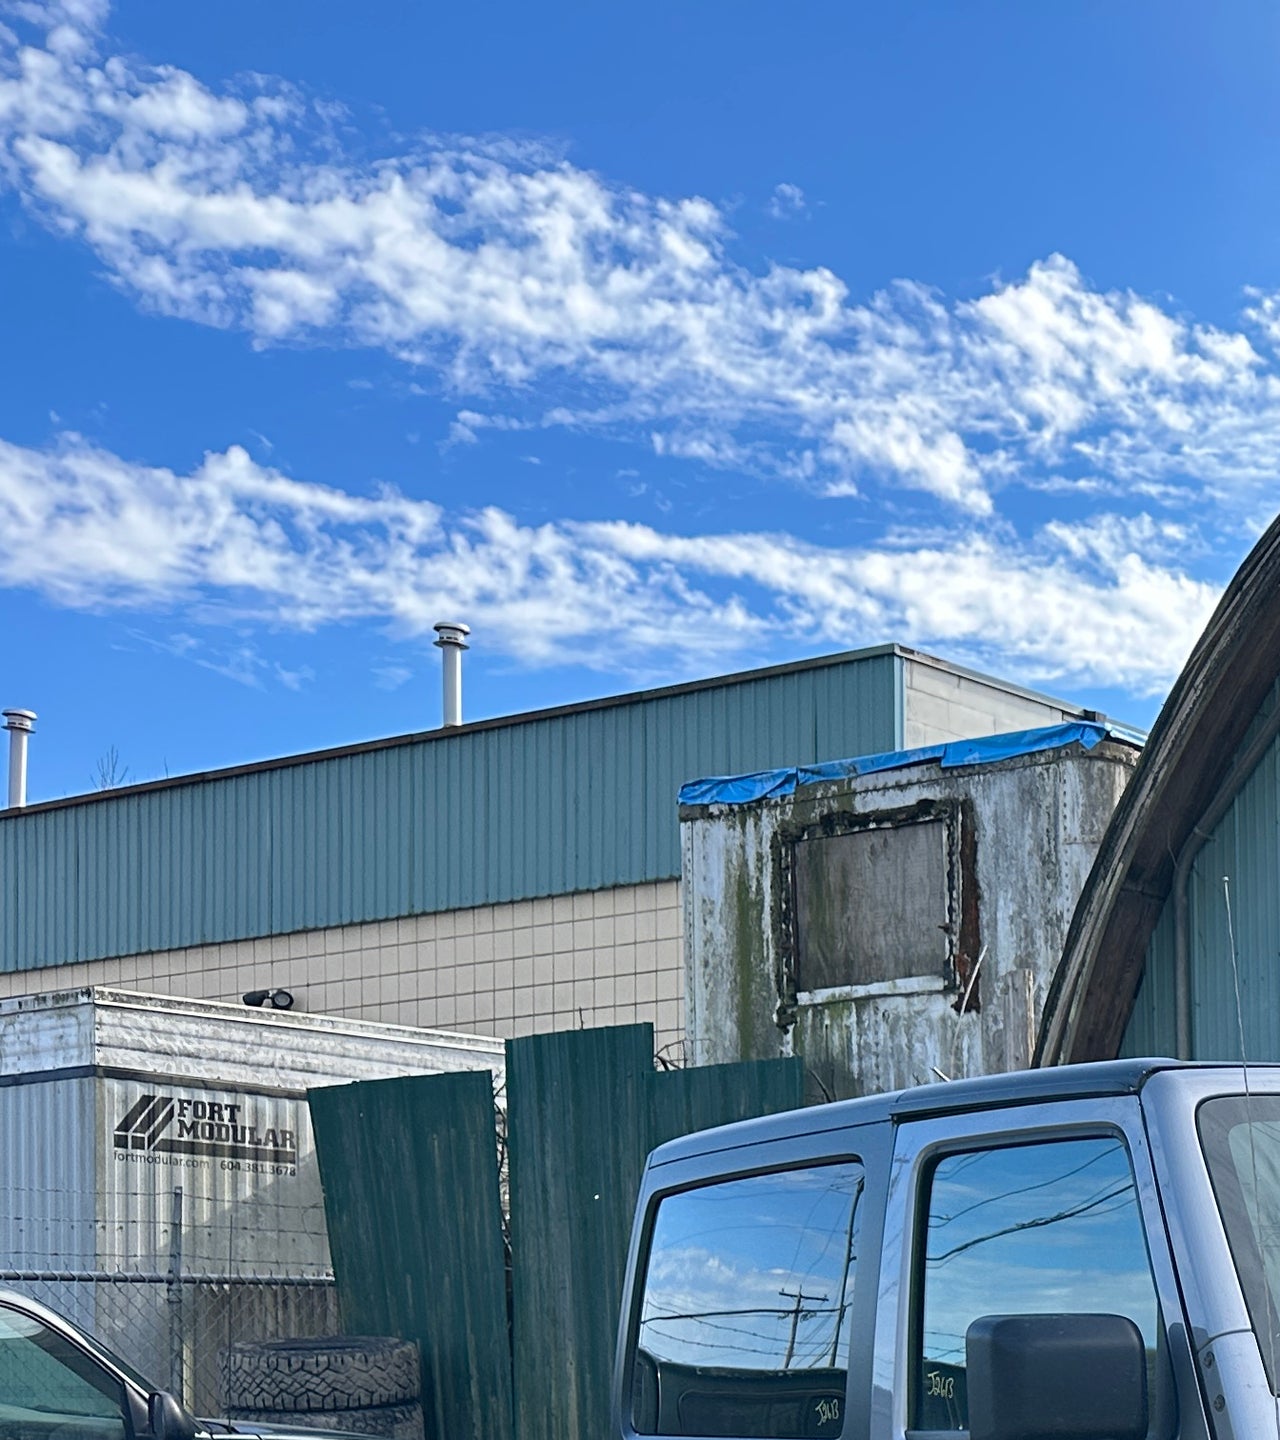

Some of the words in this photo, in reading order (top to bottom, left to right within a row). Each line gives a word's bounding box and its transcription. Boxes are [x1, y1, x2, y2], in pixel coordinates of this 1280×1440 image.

[177, 1098, 241, 1123] FORT
[177, 1119, 296, 1149] MODULAR
[114, 1150, 210, 1169] fortmodular.com
